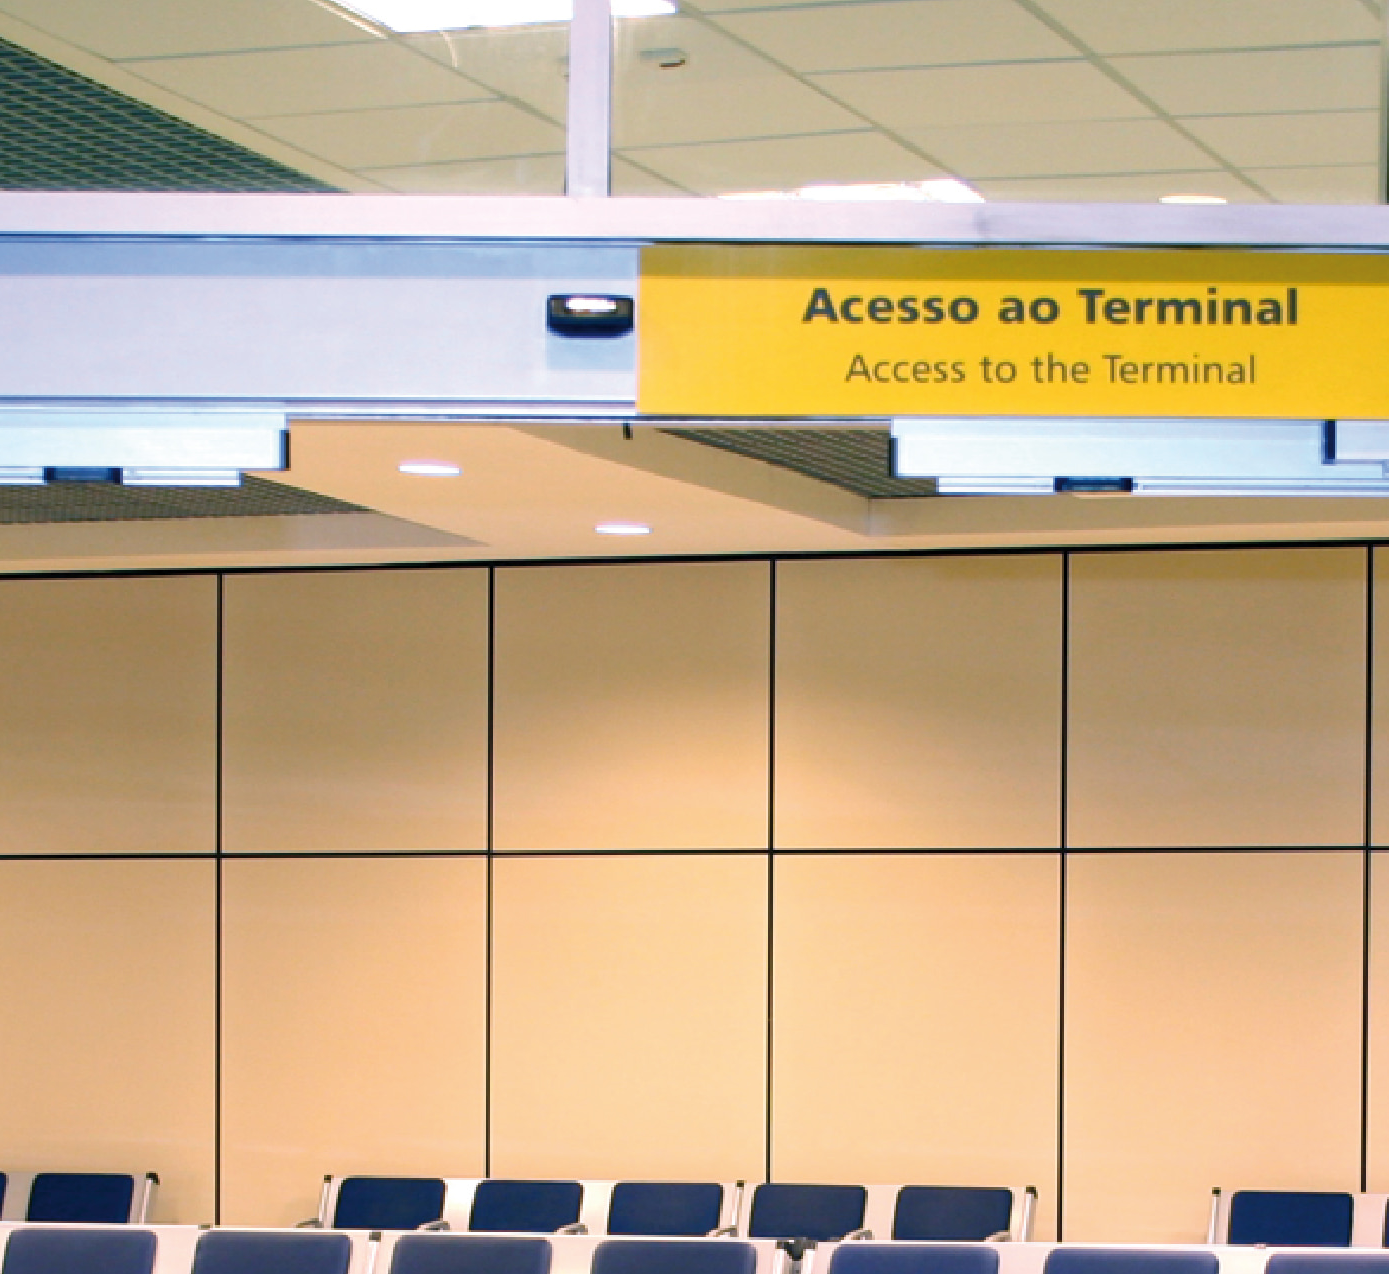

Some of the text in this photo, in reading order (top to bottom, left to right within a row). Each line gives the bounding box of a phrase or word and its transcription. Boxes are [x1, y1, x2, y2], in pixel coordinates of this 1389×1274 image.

[801, 286, 1298, 325] Acesso ao Terminal
[844, 352, 1256, 384] Access to the Terminal
